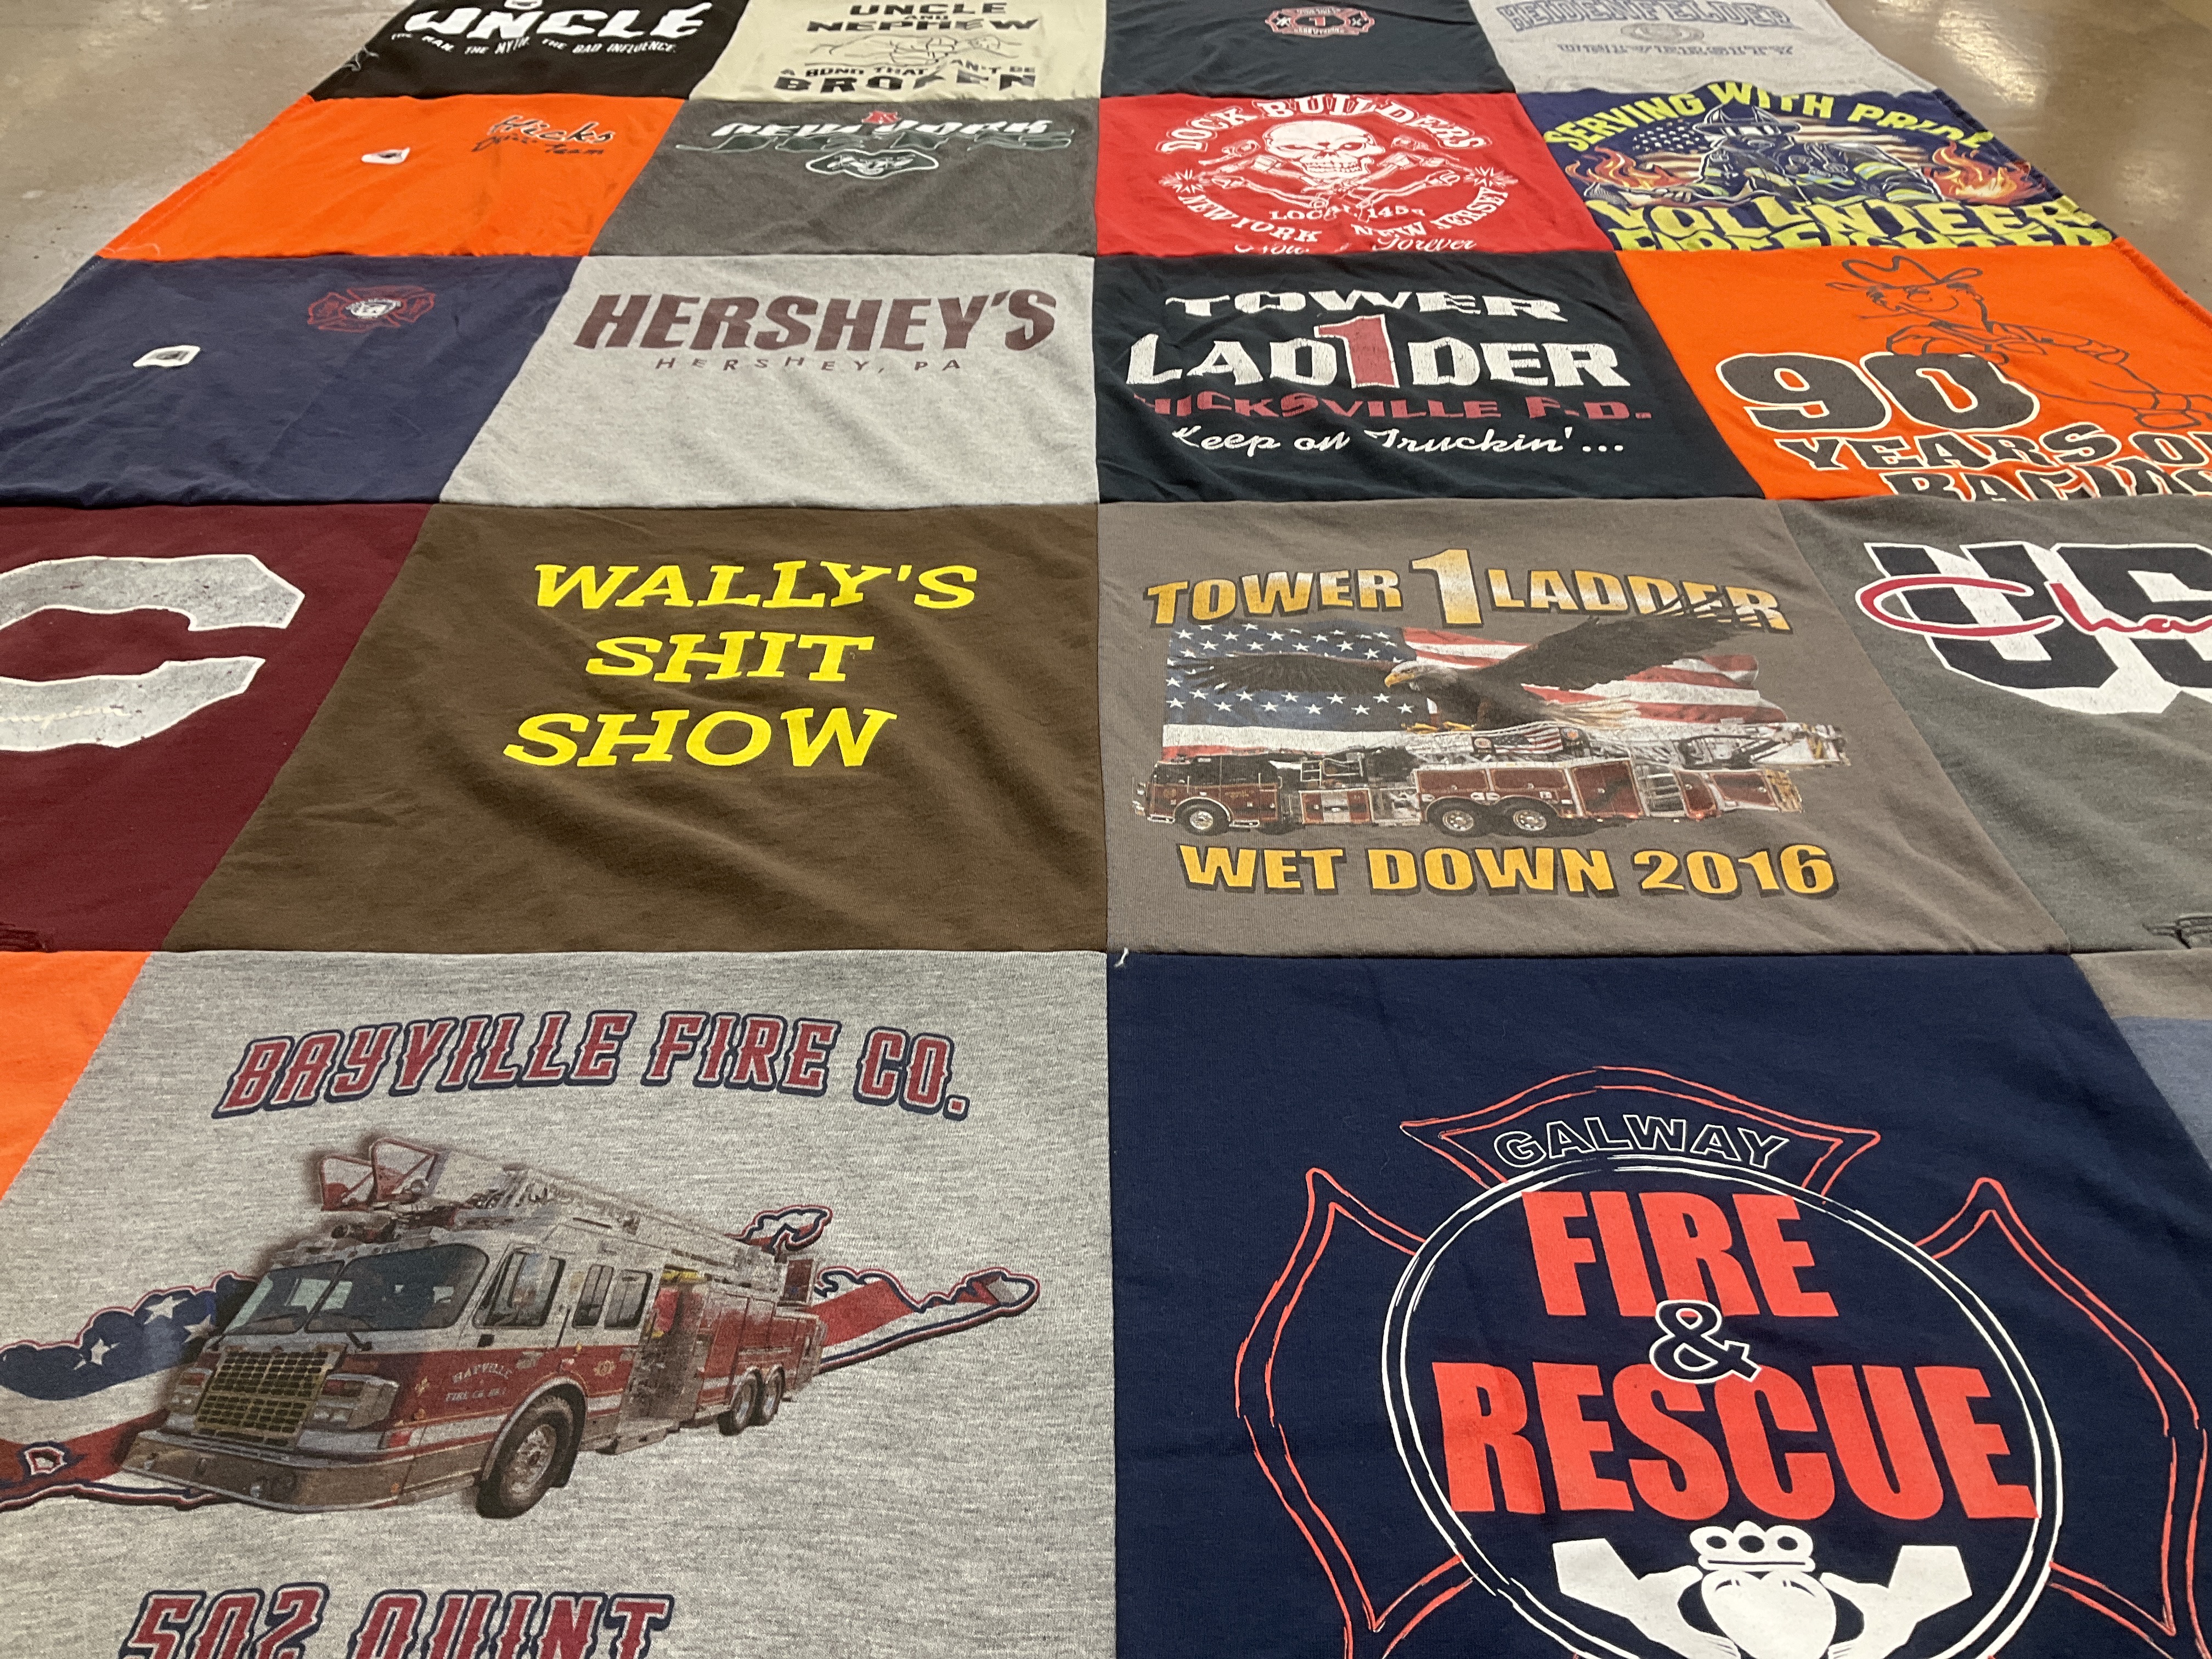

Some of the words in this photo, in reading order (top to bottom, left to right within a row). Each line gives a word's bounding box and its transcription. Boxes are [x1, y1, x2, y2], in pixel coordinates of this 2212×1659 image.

[404, 2, 713, 39] UNCLE
[806, 18, 1039, 32] NEPHEW
[850, 2, 1007, 15] UNCLE
[464, 46, 489, 55] THE
[572, 43, 603, 54] BAD
[873, 66, 928, 76] THAT
[486, 114, 616, 145] Hicks
[1156, 106, 1257, 153] DOCK
[1253, 94, 1492, 148] BUILDERS
[1543, 93, 1706, 151] SERVING
[1707, 81, 1835, 119] WITH
[1178, 194, 1239, 221] NEW
[1231, 217, 1322, 242] YORK
[1351, 221, 1427, 236] NEW
[1430, 187, 1508, 229] JERSEY
[1585, 195, 2097, 239] VOLUNTEER
[573, 290, 1056, 351] HERSHEY'S
[1165, 289, 1568, 322] TOWER
[914, 359, 961, 372] PA
[1715, 351, 2040, 433] 90
[1526, 396, 1652, 420] F.D.
[1171, 425, 1280, 457] Keep
[1293, 431, 1350, 452] on
[1775, 421, 2121, 471] YEARS
[2127, 431, 2212, 467] O
[534, 560, 978, 609] WALLY'S
[1147, 567, 1404, 627] TOWER
[1410, 548, 1483, 628] 1
[1487, 569, 1794, 634] LADDER
[585, 631, 874, 683] SHIT
[503, 708, 898, 768] SHOW
[1179, 844, 1344, 894] WET
[1367, 845, 1620, 899] DOWN
[1632, 842, 1840, 899] 2016
[211, 1011, 639, 1118] BAYVILLE
[643, 1011, 840, 1095] FIRE
[853, 1025, 970, 1121] CO.
[1493, 1114, 1789, 1170] GALWAY
[1521, 1190, 1839, 1317] FIRE
[1649, 1299, 1762, 1385] &
[1432, 1361, 2039, 1521] RESCUE
[119, 1582, 330, 1659] 502
